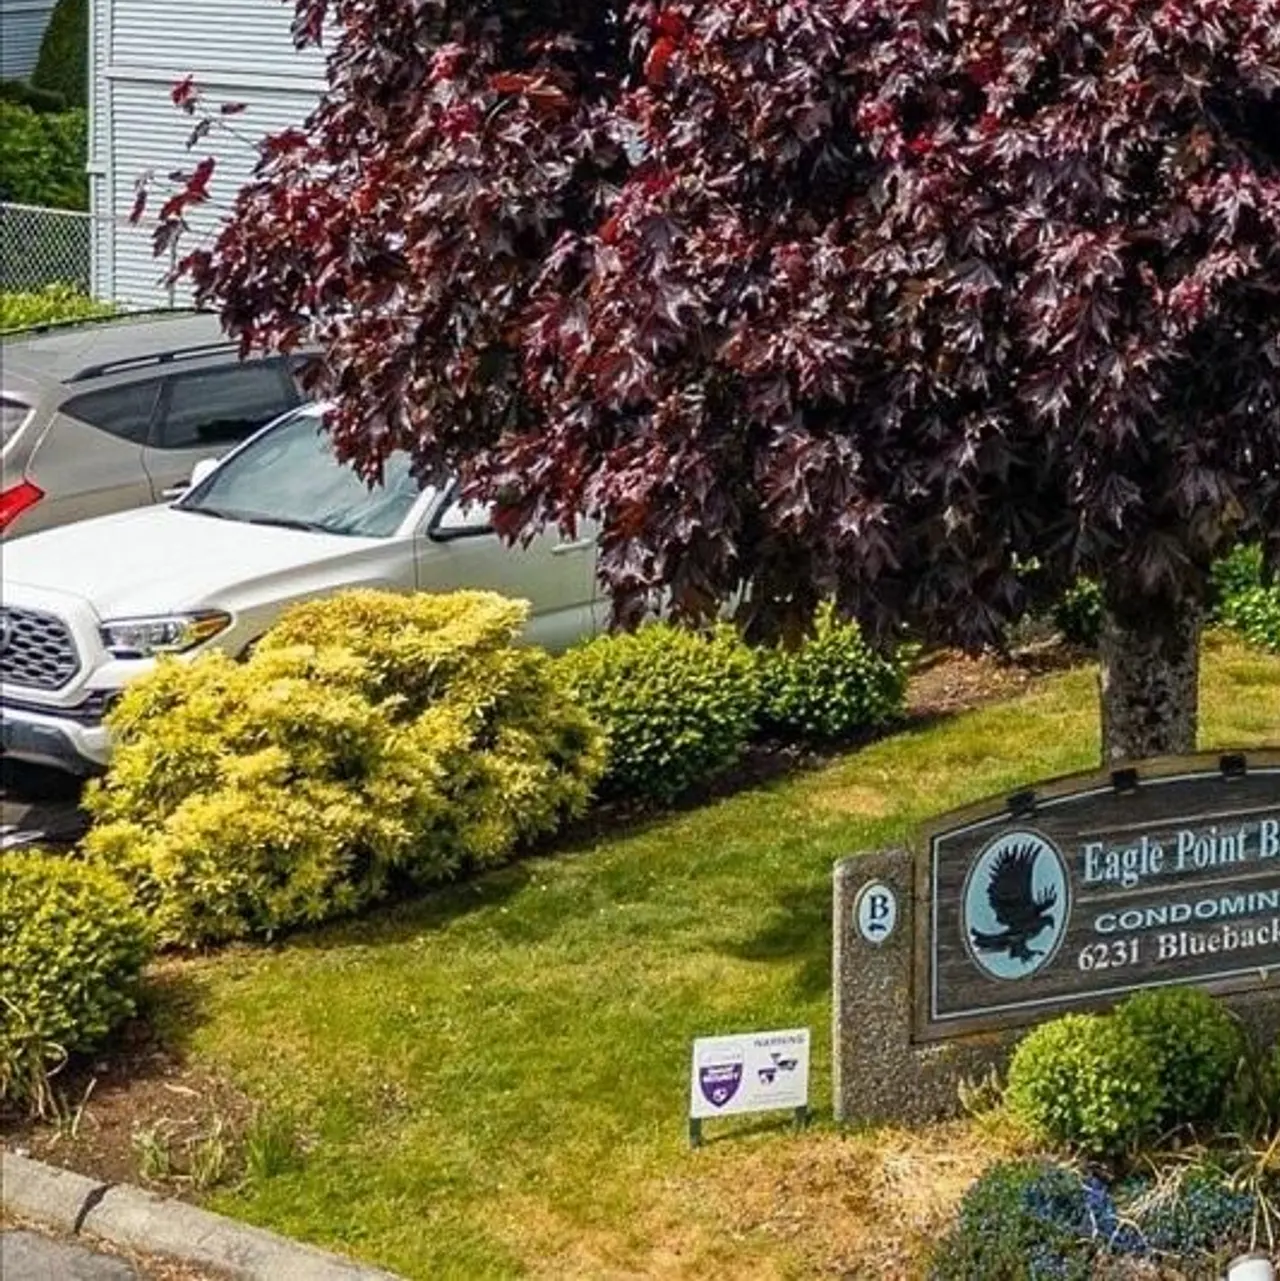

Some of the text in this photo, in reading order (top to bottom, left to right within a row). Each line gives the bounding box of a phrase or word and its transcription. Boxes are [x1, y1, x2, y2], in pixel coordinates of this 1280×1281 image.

[1083, 836, 1164, 888] Eagle
[1176, 827, 1247, 871] Point
[870, 894, 889, 920] B
[1078, 937, 1141, 970] 6231
